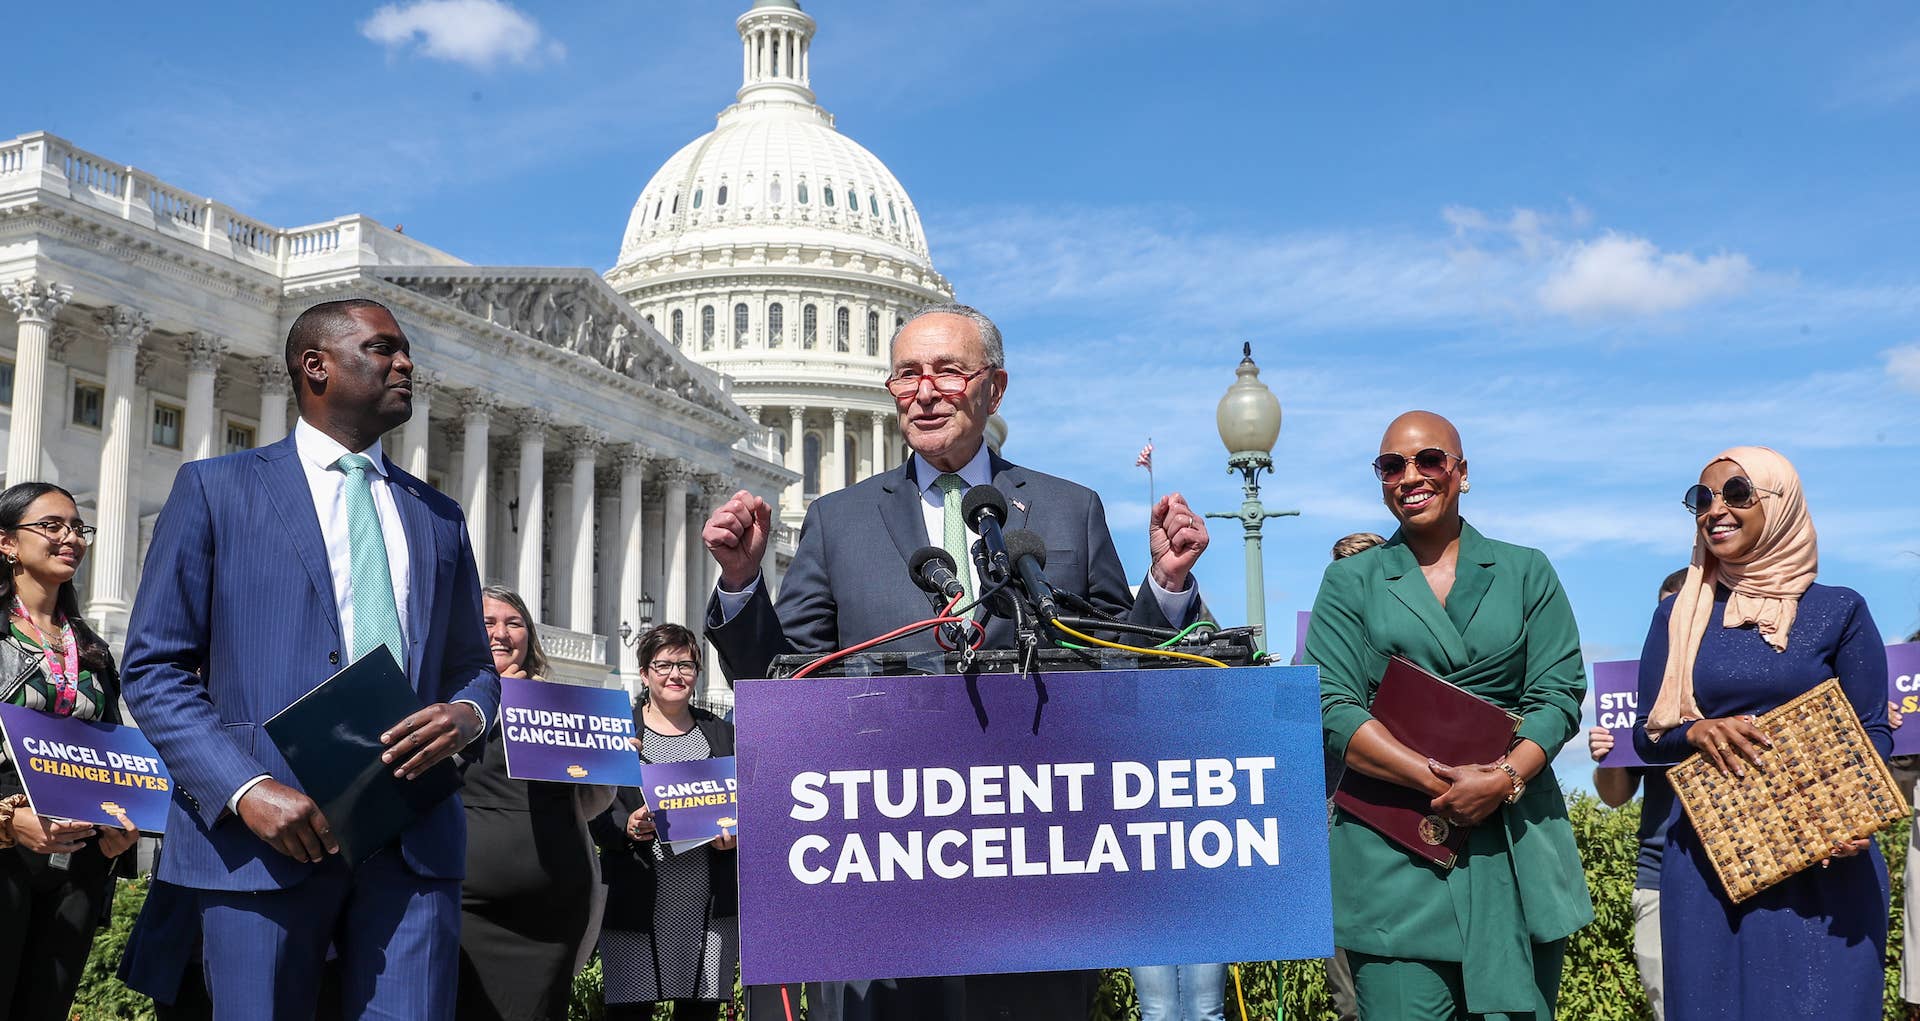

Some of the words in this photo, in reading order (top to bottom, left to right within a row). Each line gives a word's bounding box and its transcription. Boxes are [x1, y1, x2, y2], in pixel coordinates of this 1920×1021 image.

[505, 707, 586, 730] STUDENT
[588, 715, 633, 734] DEBT
[507, 726, 637, 752] CANCELLATION
[22, 736, 106, 767] CANCEL
[106, 751, 158, 774] DEBT
[29, 757, 110, 783] CHANGE
[113, 771, 169, 791] LIVES
[654, 780, 725, 798] CANCEL
[788, 762, 1095, 822] STUDENT
[1112, 756, 1276, 811] DEBT
[658, 793, 727, 810] CHANGE
[788, 817, 1280, 884] CANCELLATION
